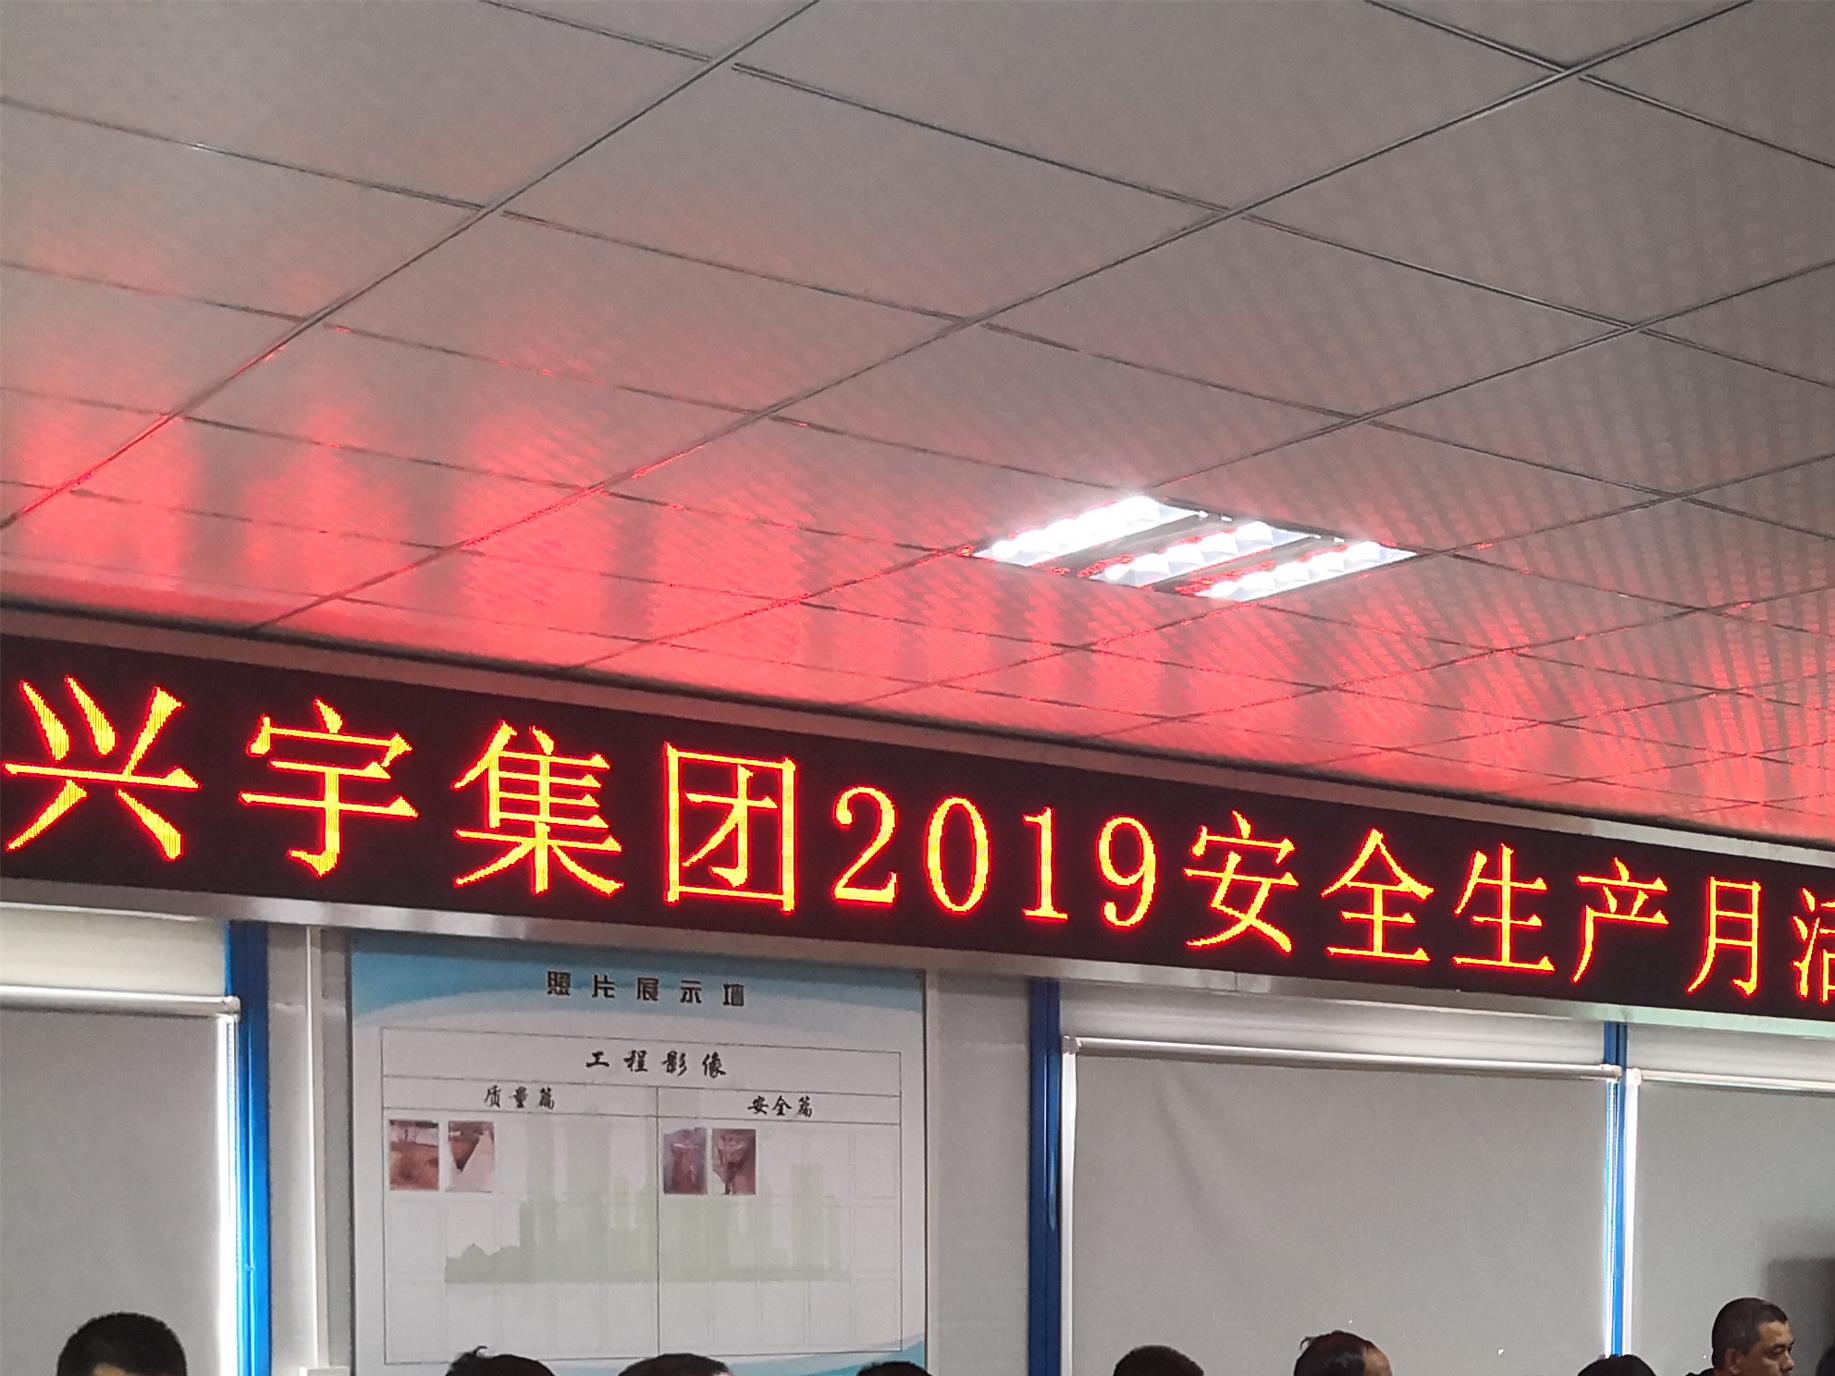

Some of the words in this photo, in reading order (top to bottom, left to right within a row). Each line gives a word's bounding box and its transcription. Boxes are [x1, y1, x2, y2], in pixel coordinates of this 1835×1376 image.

[585, 1050, 727, 1079] 工程影像
[484, 1085, 556, 1111] 质量篇
[747, 1094, 813, 1118] 安全篇
